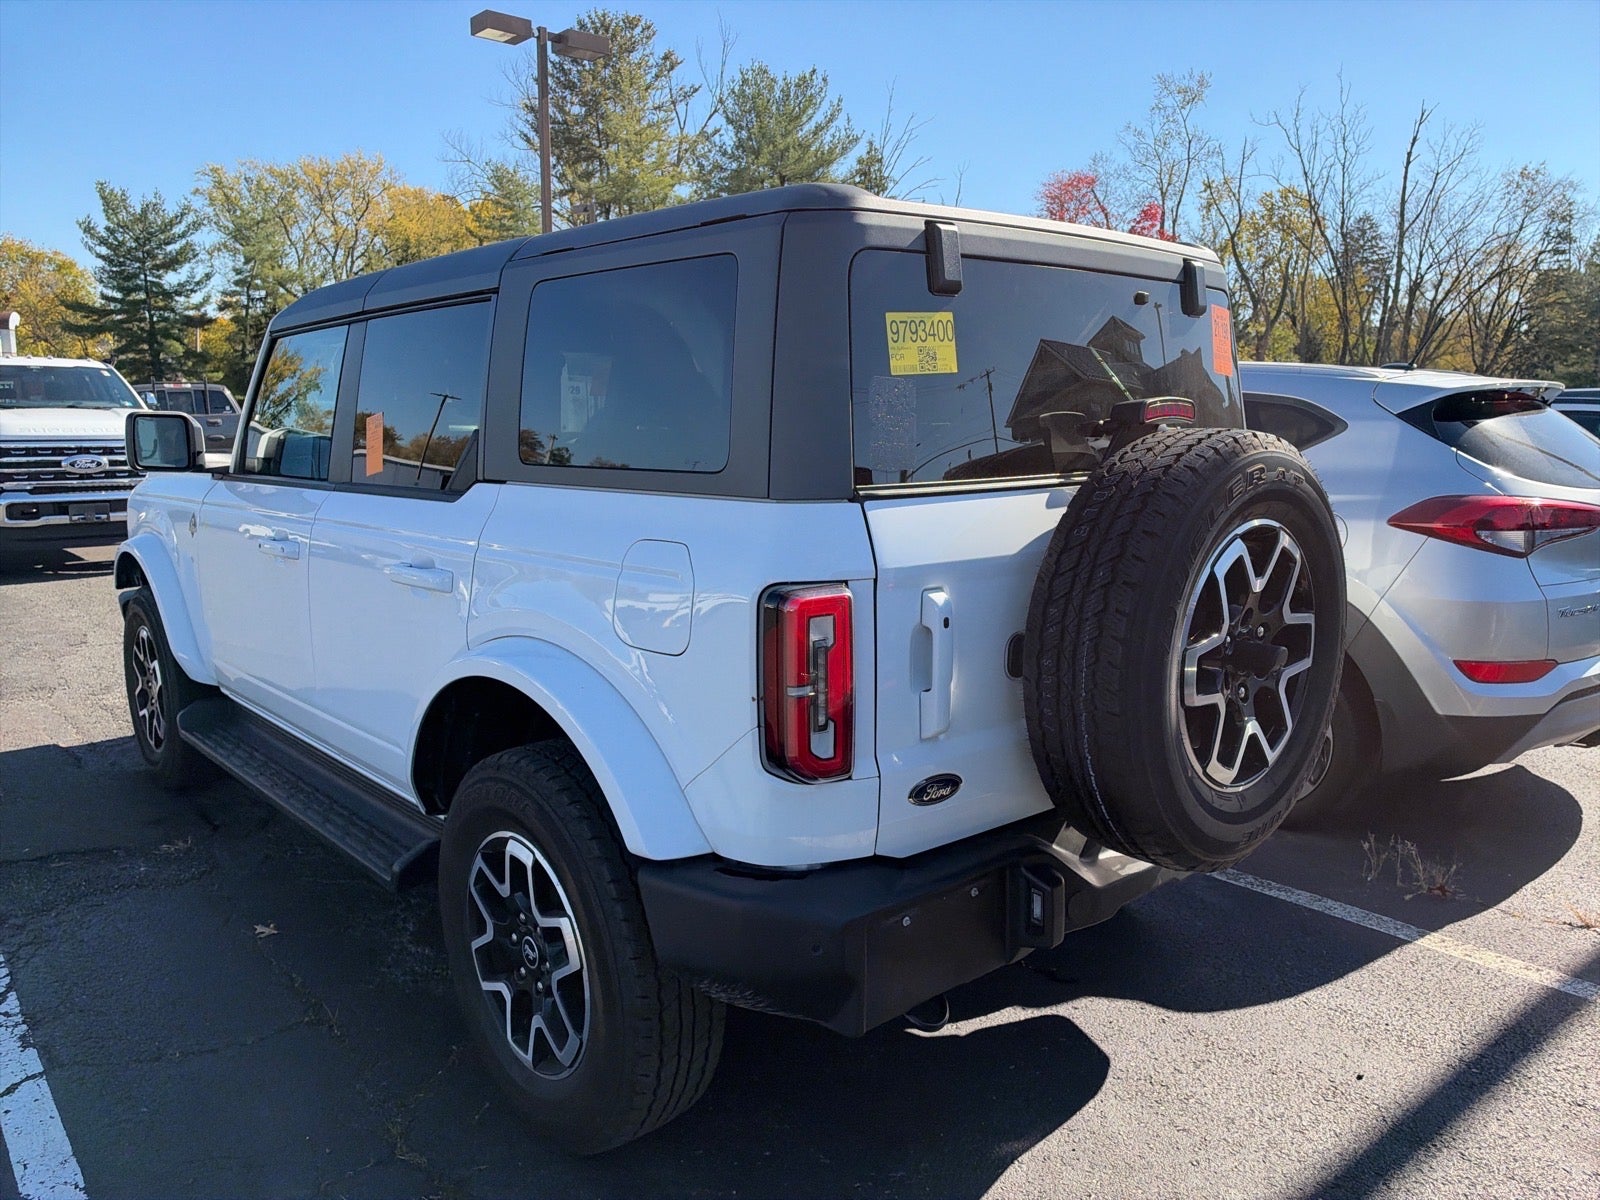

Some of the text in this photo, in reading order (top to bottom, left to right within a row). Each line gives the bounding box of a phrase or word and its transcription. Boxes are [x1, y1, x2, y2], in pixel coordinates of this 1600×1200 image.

[889, 319, 954, 344] 9793400
[75, 459, 97, 469] Ford
[923, 782, 953, 801] Ford
